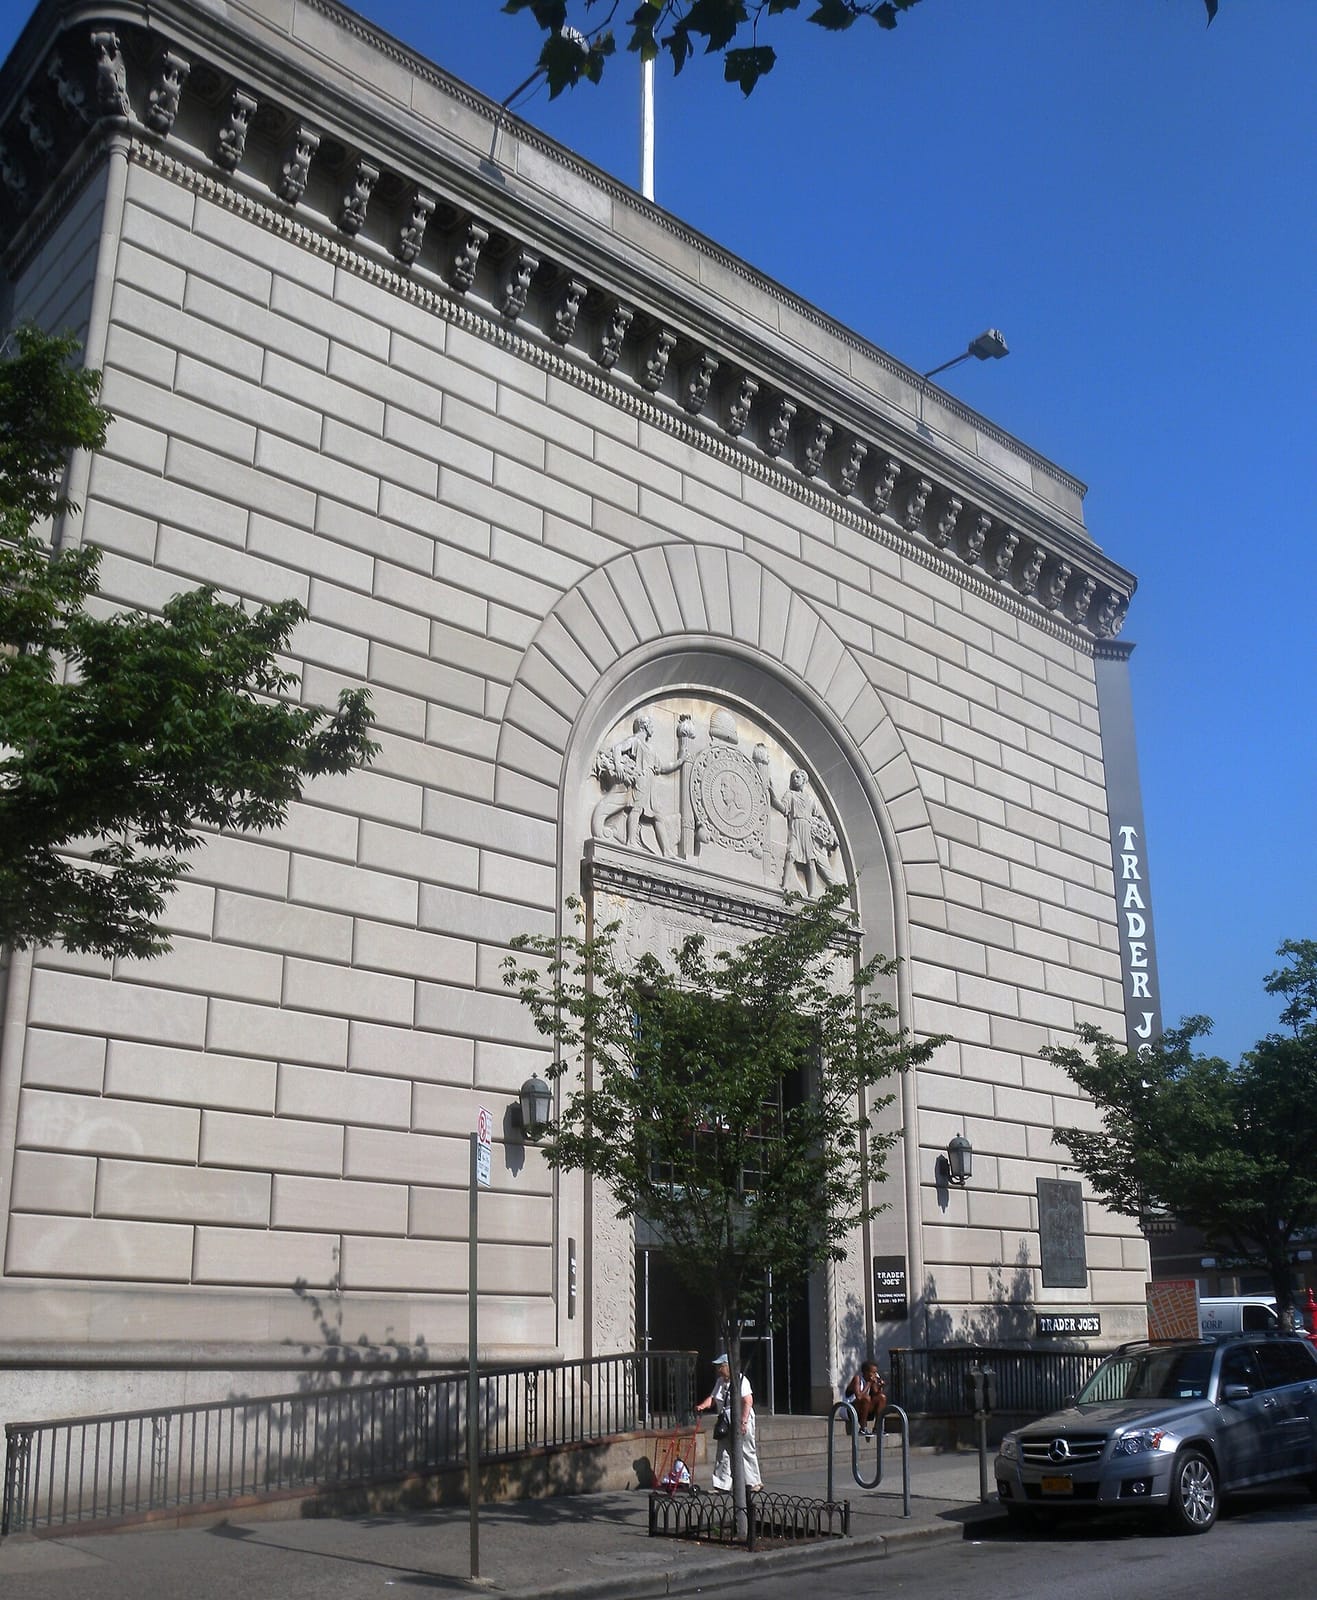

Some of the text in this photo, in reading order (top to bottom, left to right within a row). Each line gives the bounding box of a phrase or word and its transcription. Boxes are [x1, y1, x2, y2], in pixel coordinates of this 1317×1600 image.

[1118, 825, 1152, 998] TRADER
[1040, 1318, 1099, 1331] TRADER JOE'S
